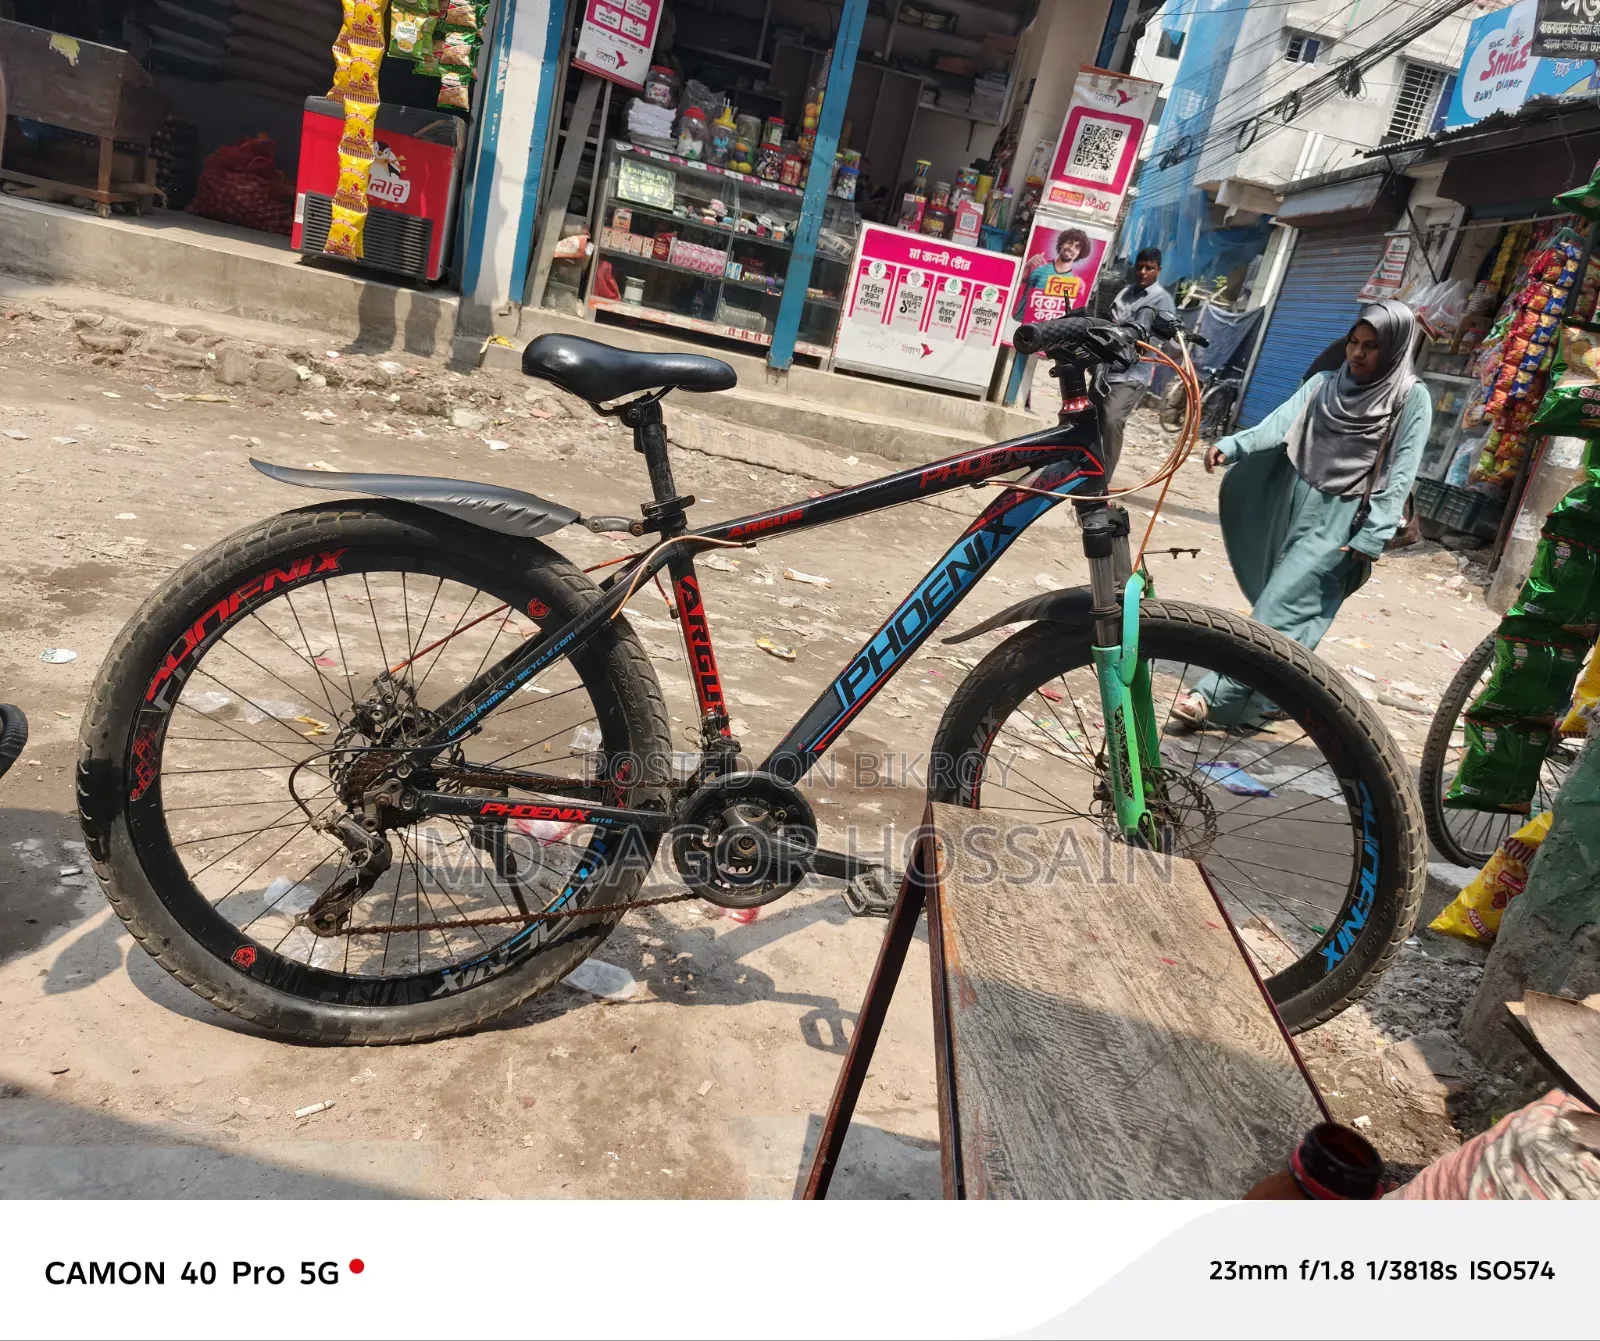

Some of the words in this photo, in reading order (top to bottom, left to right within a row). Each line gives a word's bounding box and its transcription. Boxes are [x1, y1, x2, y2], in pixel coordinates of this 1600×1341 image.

[1488, 38, 1505, 50] SMC
[1480, 40, 1534, 81] SMILE
[1474, 88, 1494, 102] Baby
[1496, 79, 1522, 92] Diaper
[909, 248, 921, 260] মা
[922, 249, 950, 267] জননী
[1049, 277, 1078, 294] বিল
[727, 509, 804, 538] ARGUS
[843, 510, 1016, 702] PHOENIX
[480, 803, 592, 821] PHOENIX
[590, 817, 613, 825] MTB
